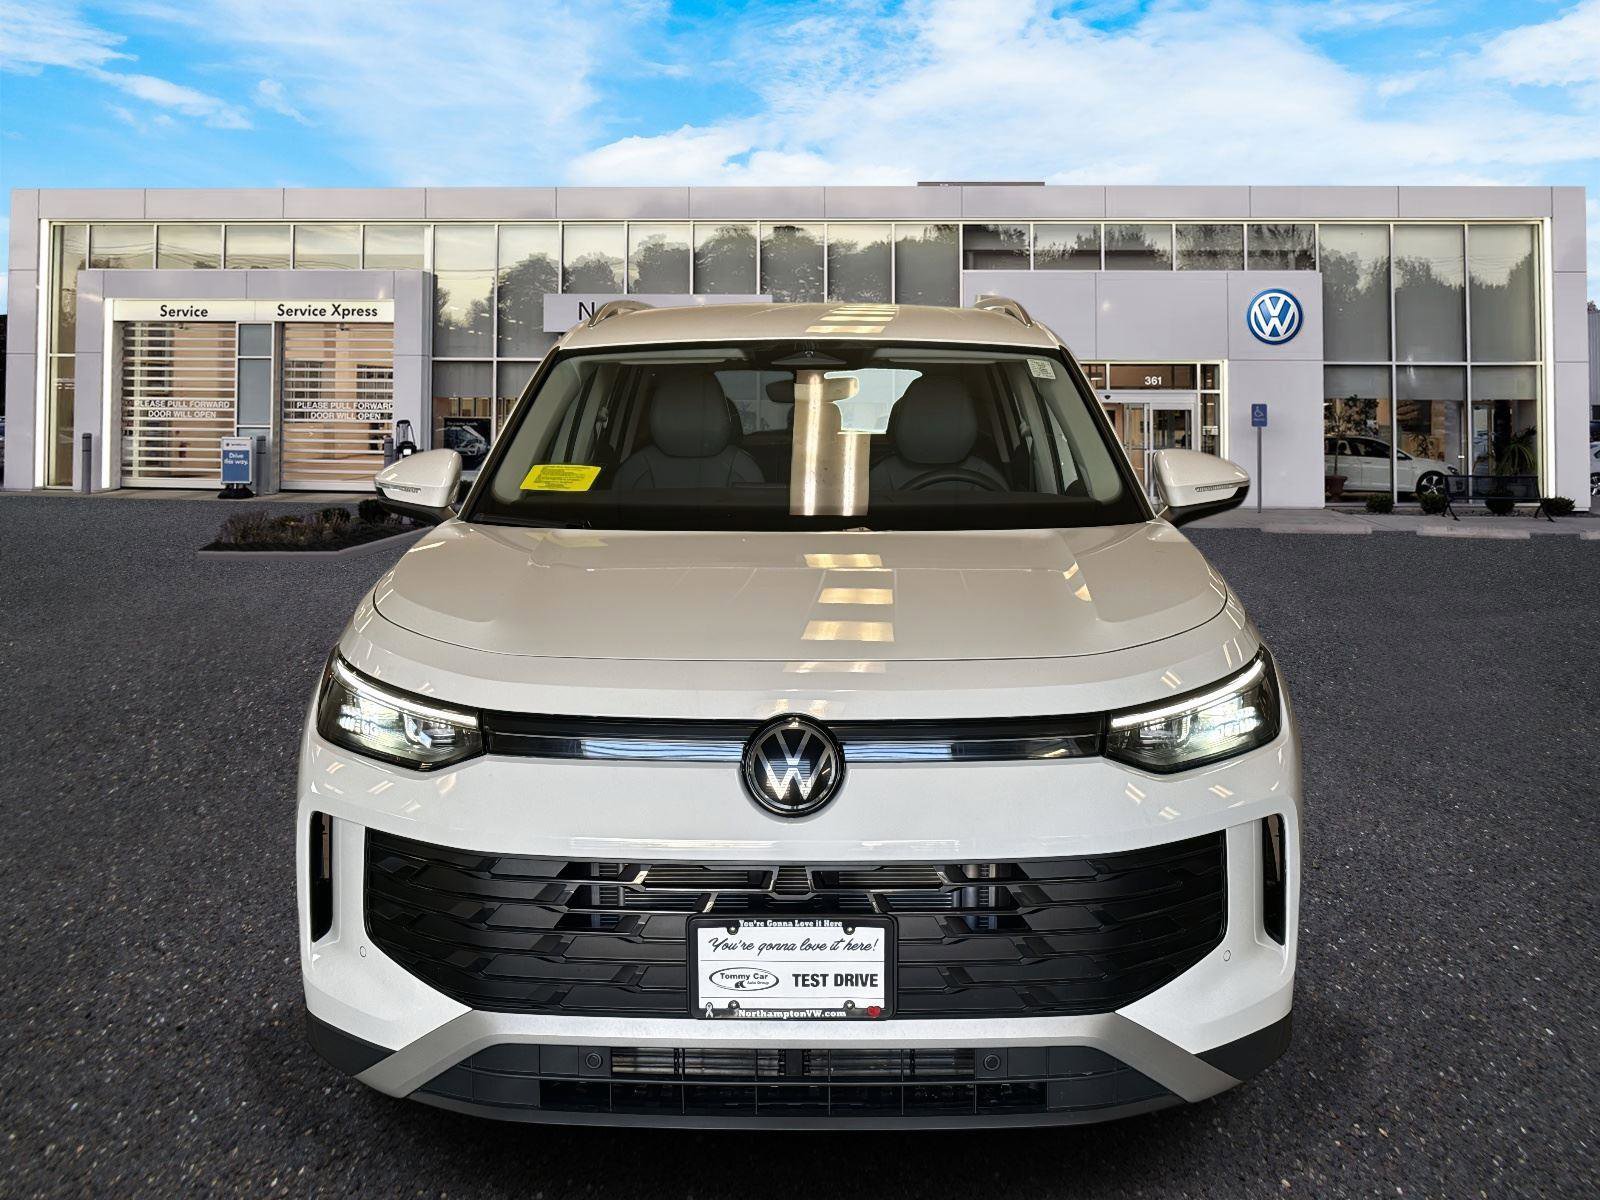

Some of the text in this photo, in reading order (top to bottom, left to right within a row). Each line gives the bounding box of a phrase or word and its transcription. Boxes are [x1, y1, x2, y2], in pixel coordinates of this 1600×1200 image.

[159, 304, 209, 318] Service
[276, 303, 378, 318] Service Xpress
[1144, 376, 1162, 386] 361
[135, 400, 230, 409] PLEASE PULL FORWARD
[296, 401, 393, 410] PLEASE PULL FORWARD
[148, 410, 172, 418] DOOR
[172, 410, 192, 418] WILL
[310, 411, 381, 420] DOOR WILL OPEN
[739, 919, 843, 927] You're Gonna Love it Here
[708, 937, 879, 956] You're gonna love it here!
[719, 972, 768, 981] Tommy Car
[792, 973, 878, 987] TEST DRIVE
[738, 1010, 846, 1019] NorthamptonVW.com
